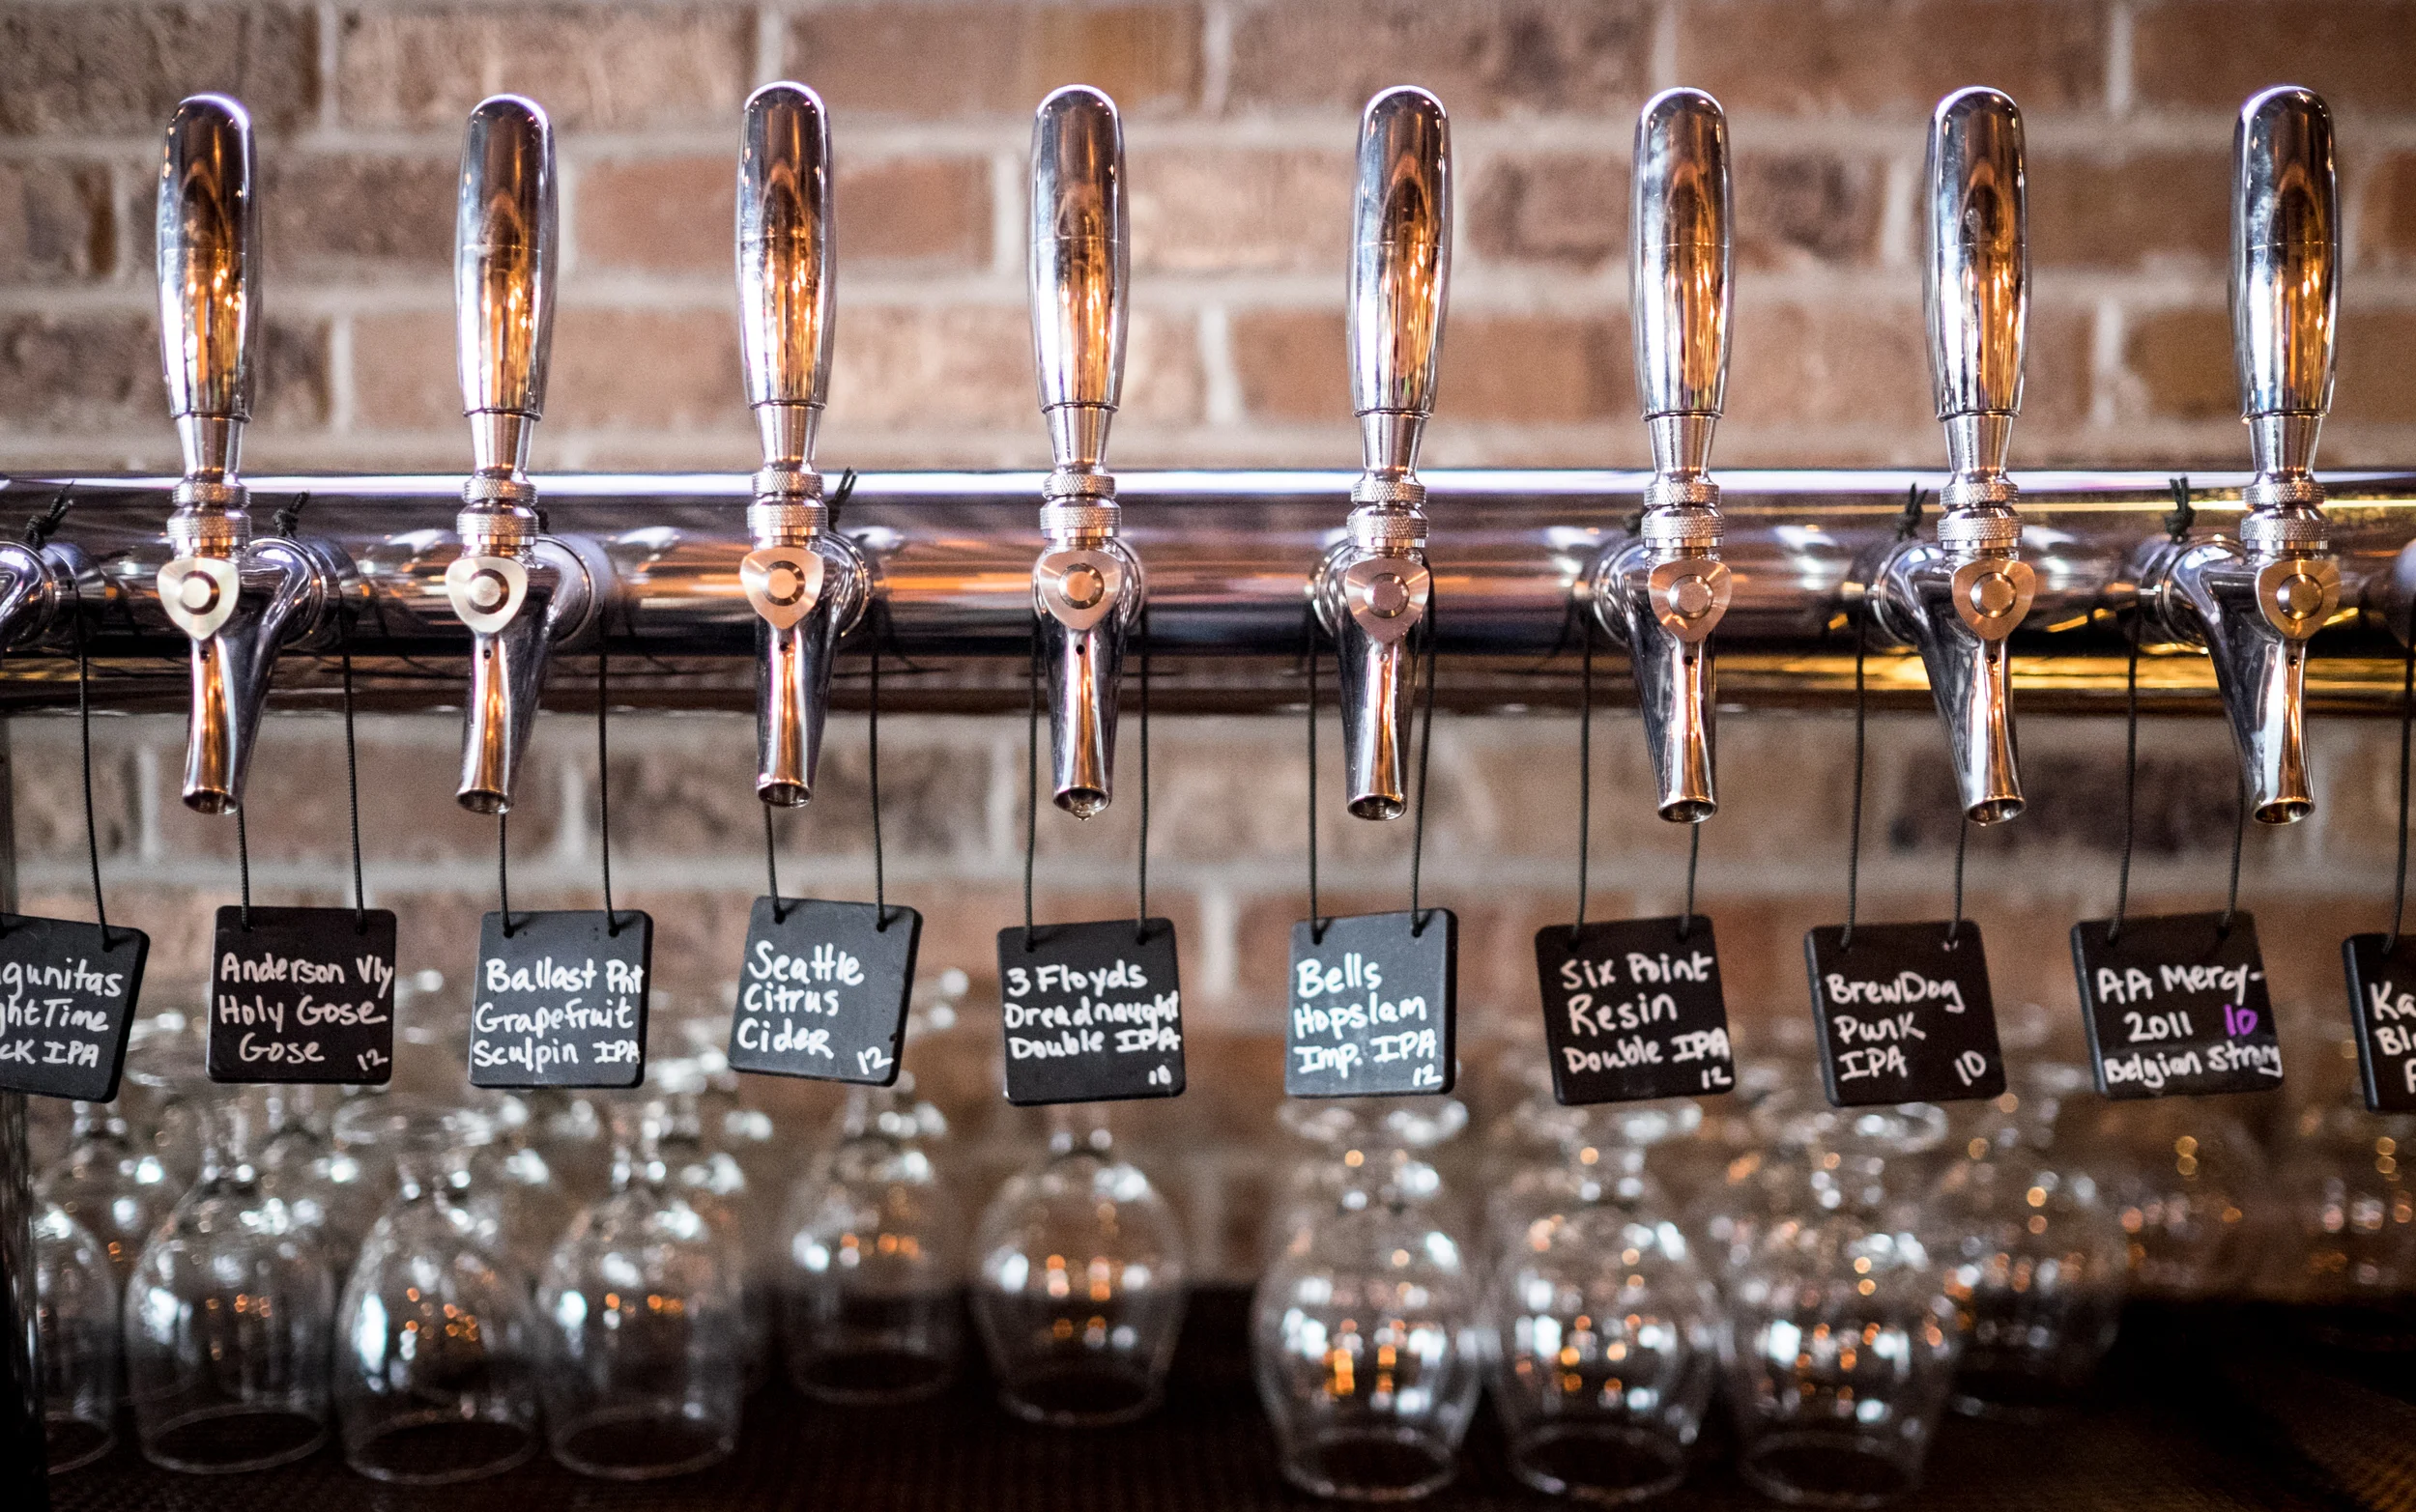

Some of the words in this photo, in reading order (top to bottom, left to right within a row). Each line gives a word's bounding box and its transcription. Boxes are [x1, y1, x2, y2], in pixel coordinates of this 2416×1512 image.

[0, 957, 123, 1000] gunitas
[220, 952, 345, 984] Anderson
[356, 955, 393, 999] Vly
[486, 956, 597, 992] Ballast
[747, 940, 865, 985] Seattle
[1007, 967, 1031, 997] 3
[1035, 958, 1148, 997] Floyds
[1296, 953, 1382, 998] Bells
[1560, 958, 1616, 989] Six
[1625, 951, 1714, 984] Point
[743, 982, 839, 1016] Citrus
[1826, 971, 1965, 1013] BrewDog
[2097, 967, 2153, 1004] AA
[218, 994, 284, 1033] Holy
[297, 994, 388, 1026] Gose
[475, 996, 634, 1039] Grapefruit
[1003, 990, 1179, 1031] Dreadnaught
[1293, 991, 1427, 1040] Hopslam
[1568, 992, 1678, 1037] Resin
[2123, 1011, 2194, 1042] 2011
[2225, 1004, 2258, 1036] 10
[42, 1041, 100, 1068] IPA
[240, 1032, 325, 1064] Gose
[473, 1036, 579, 1073] Sculpin
[592, 1040, 640, 1064] IPA
[1009, 1029, 1105, 1059] Double
[1114, 1026, 1181, 1053] IPA
[1293, 1042, 1363, 1079] Imp.
[1369, 1028, 1437, 1063] IPA
[1563, 1035, 1663, 1074] Double
[1670, 1027, 1731, 1063] IPA
[2374, 1024, 2416, 1056] Bl
[357, 1048, 388, 1071] 12
[857, 1046, 894, 1075] 12
[1413, 1063, 1443, 1087] 12
[1701, 1066, 1732, 1090] 12
[1838, 1044, 1908, 1082] IPA
[1954, 1050, 1987, 1087] 10
[2103, 1051, 2202, 1089] Belgian
